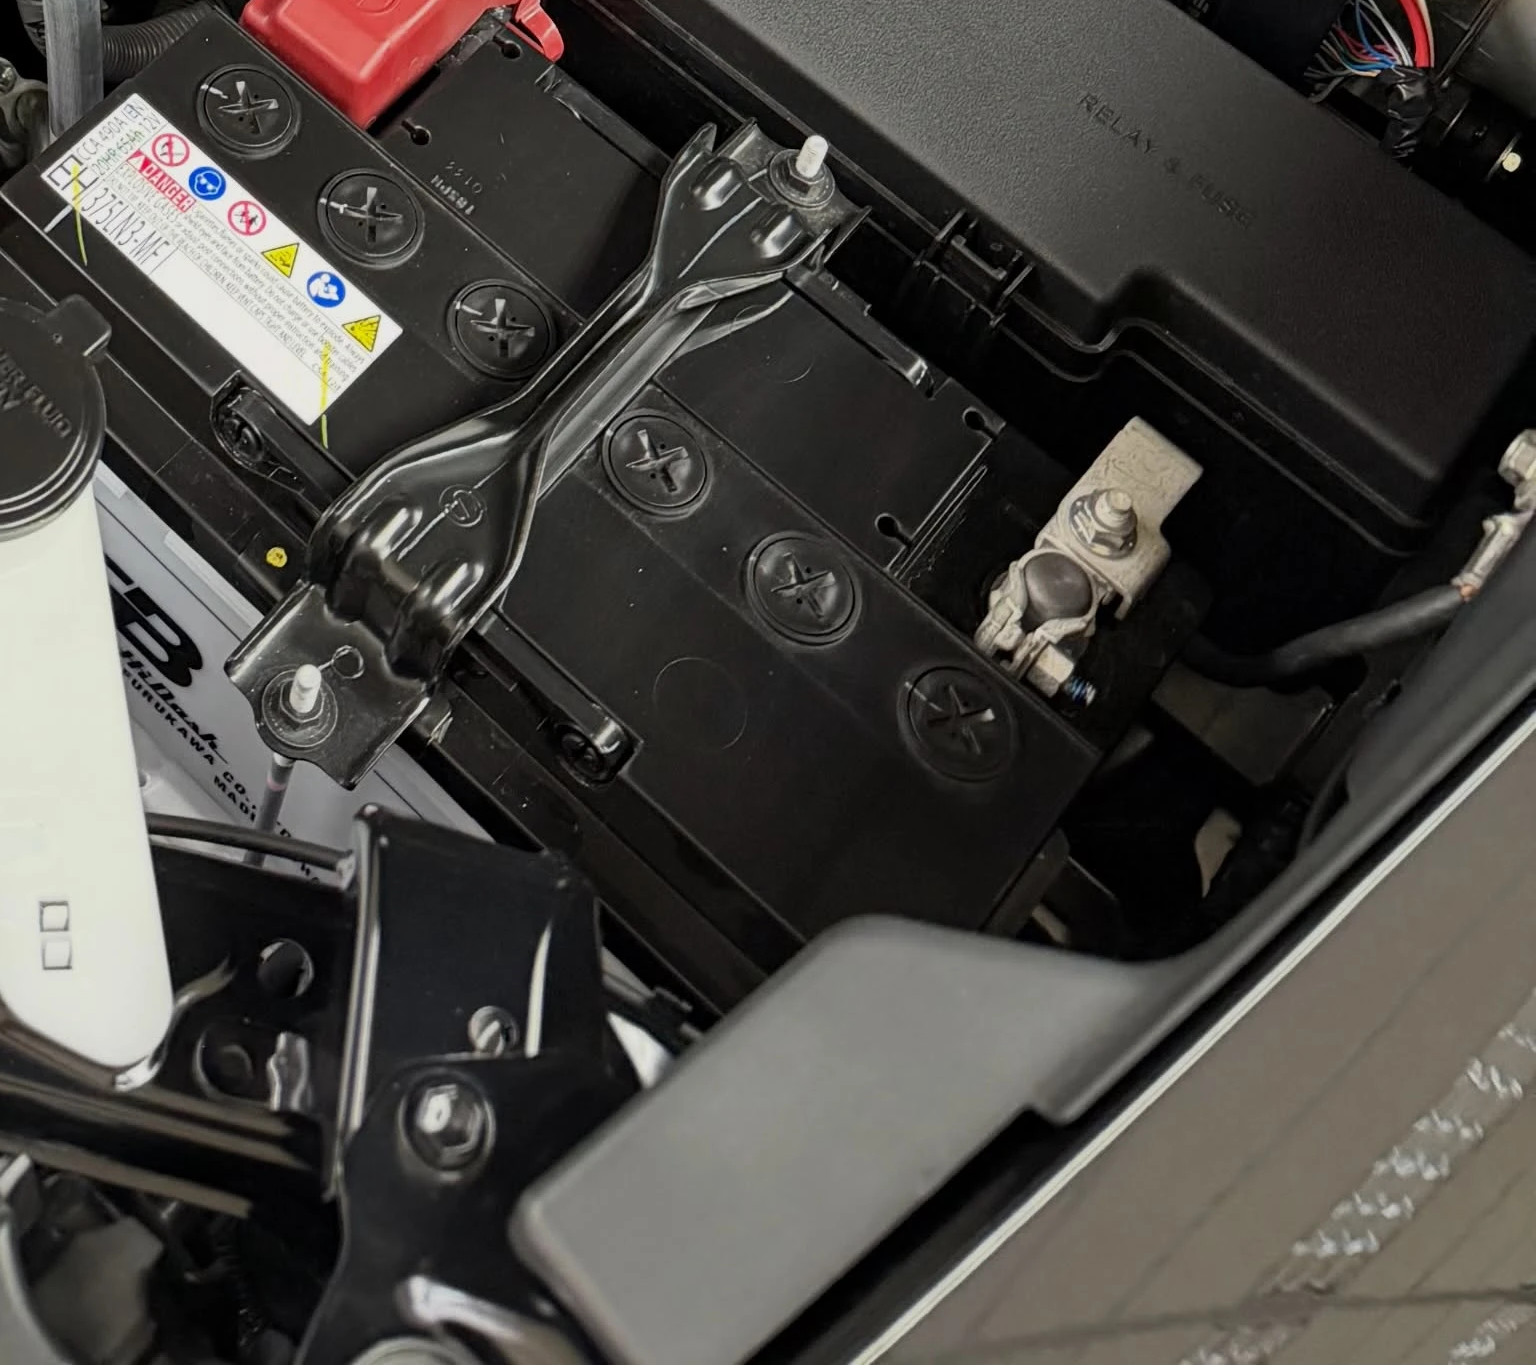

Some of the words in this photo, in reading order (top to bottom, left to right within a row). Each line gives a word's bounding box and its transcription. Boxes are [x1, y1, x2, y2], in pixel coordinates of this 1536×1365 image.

[74, 135, 104, 162] CCA
[95, 114, 128, 143] 490A
[1077, 90, 1161, 160] RELAY
[139, 161, 196, 212] DANGER
[77, 183, 171, 269] 375LN3-MF
[23, 382, 76, 440] FLUID
[122, 667, 215, 766] FURUKAWA
